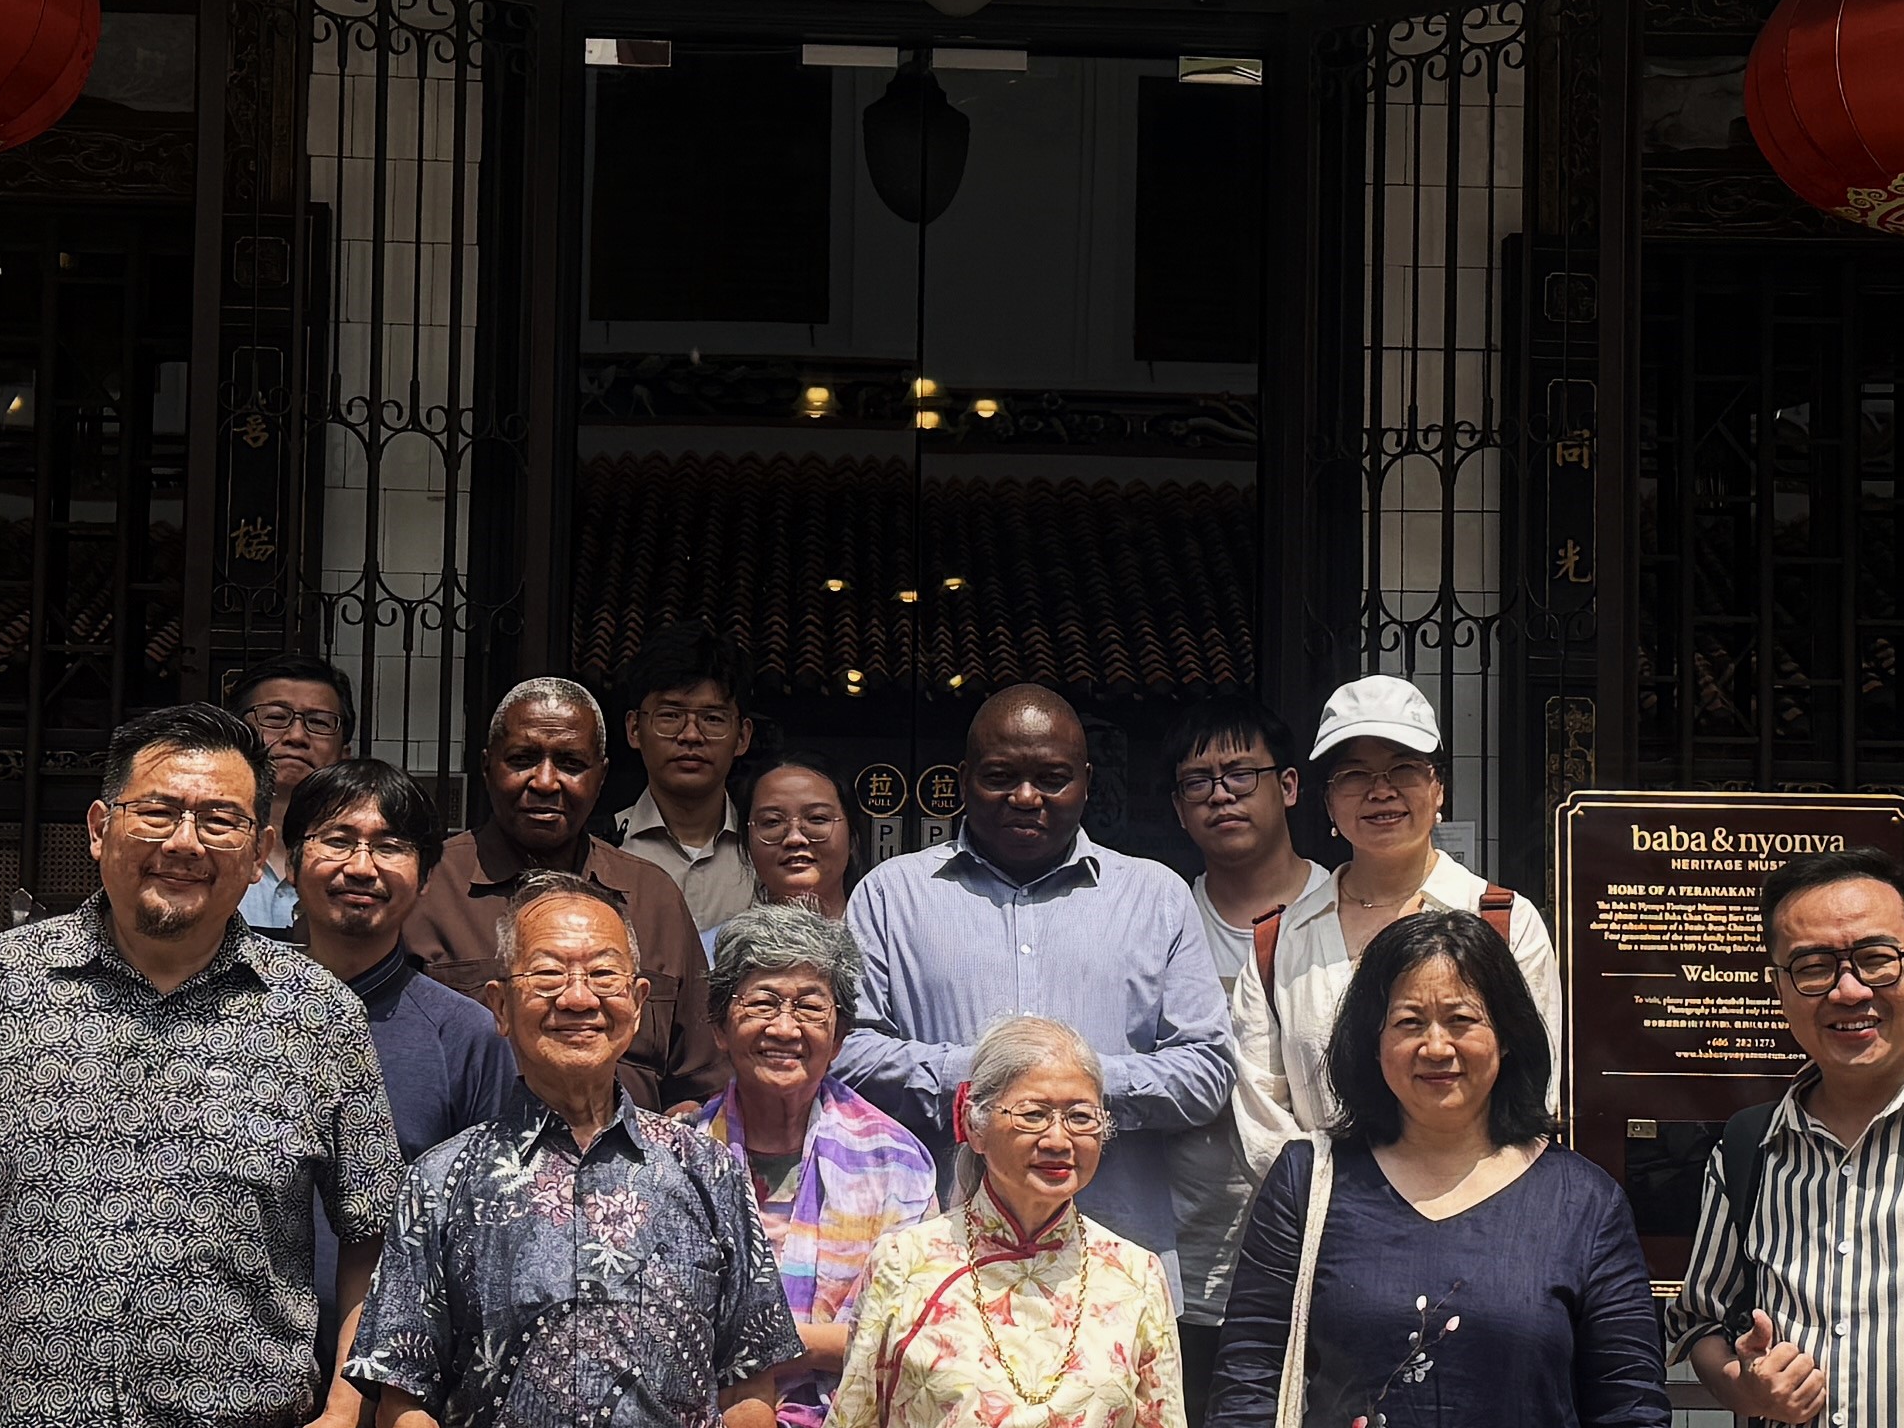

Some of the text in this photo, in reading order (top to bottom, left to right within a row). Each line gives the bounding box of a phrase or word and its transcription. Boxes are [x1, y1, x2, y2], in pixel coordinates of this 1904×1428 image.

[869, 773, 892, 797] 拉
[932, 775, 955, 798] 拉
[868, 798, 891, 807] PULL
[931, 800, 955, 808] PULL
[1671, 859, 1743, 870] HERITAGE
[1607, 884, 1645, 895] HOME
[1648, 885, 1665, 895] OF
[1667, 886, 1677, 896] A
[1679, 886, 1756, 897] PERANAKAN
[1680, 964, 1759, 983] Welcome
[1735, 1038, 1752, 1047] 282
